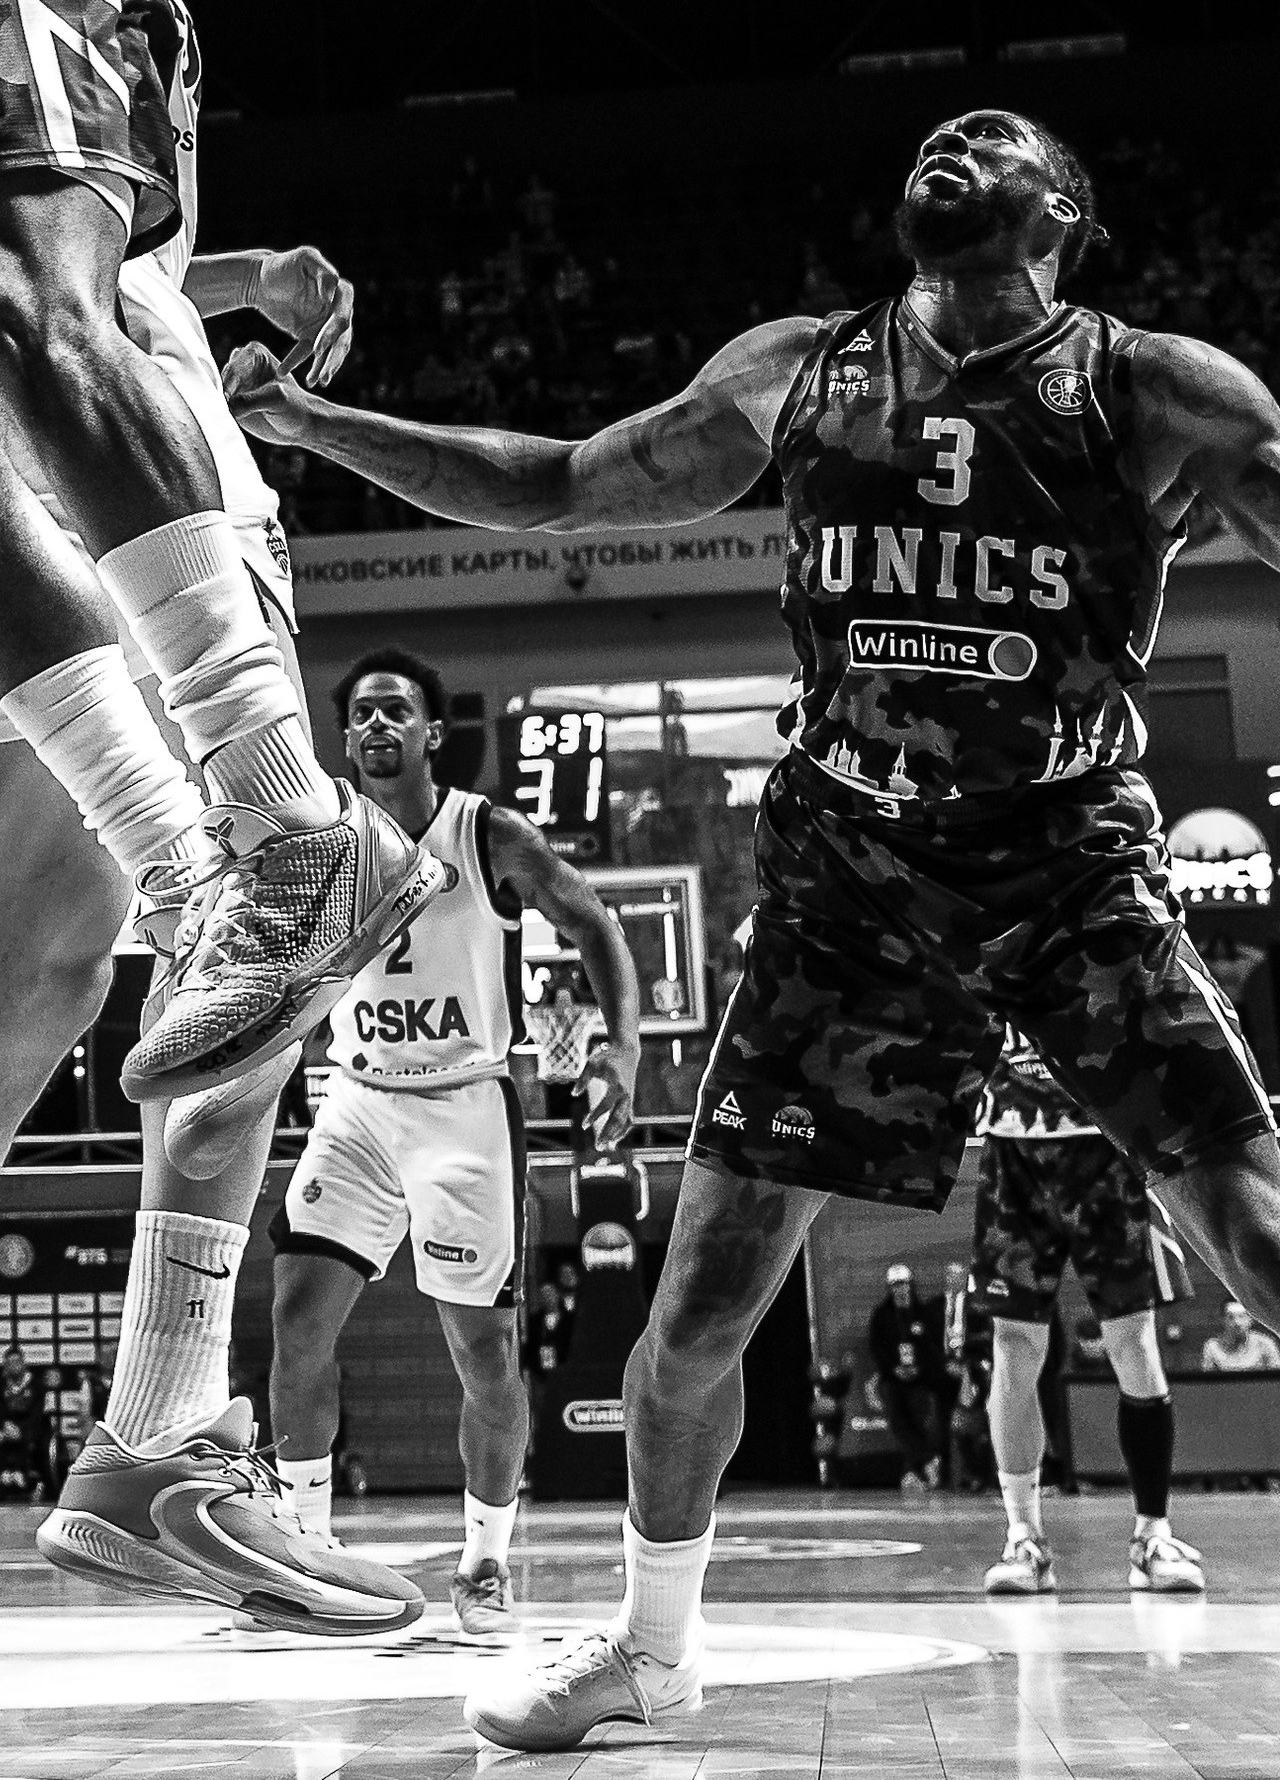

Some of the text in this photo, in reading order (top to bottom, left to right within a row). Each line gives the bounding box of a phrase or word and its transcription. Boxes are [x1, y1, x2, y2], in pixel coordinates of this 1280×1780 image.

[917, 416, 976, 506] 3
[294, 552, 444, 585] НКОВСКИЕ
[561, 538, 662, 569] ЧТОБЫ
[669, 532, 754, 563] ЖИТЬ
[821, 524, 1070, 610] UNICS
[854, 630, 979, 665] Winline
[520, 712, 605, 757] 6:37
[876, 797, 902, 819] 3
[384, 928, 413, 976] 2
[354, 996, 470, 1043] CSKA
[712, 1108, 747, 1131] PEAK
[772, 1119, 816, 1139] UNICS
[186, 1299, 206, 1319] 11
